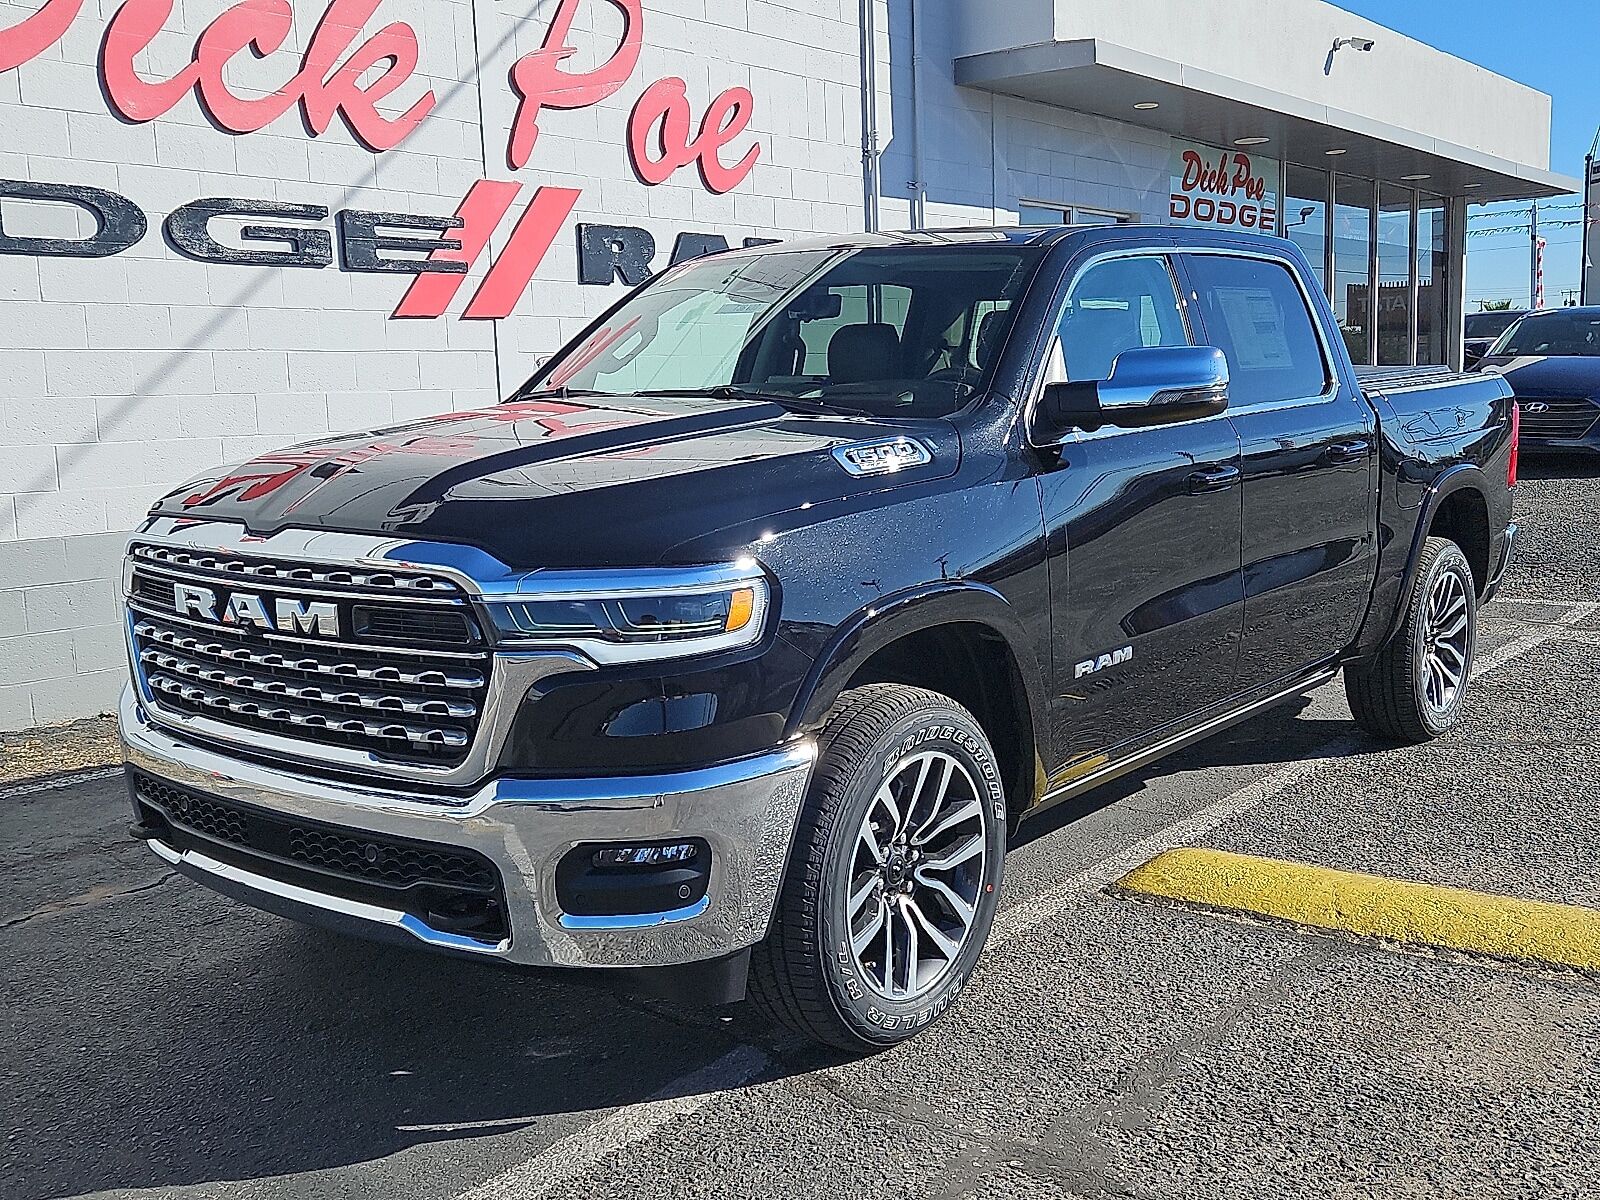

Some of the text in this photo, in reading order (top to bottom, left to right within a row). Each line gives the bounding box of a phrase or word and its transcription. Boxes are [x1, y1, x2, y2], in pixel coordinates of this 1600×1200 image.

[0, 0, 761, 195] ick Poe
[1181, 150, 1266, 201] Dick Poe
[1169, 193, 1276, 231] DODGE
[845, 441, 915, 466] 1500
[173, 582, 340, 638] RAM
[1074, 645, 1133, 679] RAM
[881, 725, 1005, 821] BRIDGESTONE
[866, 973, 964, 1030] DUELER
